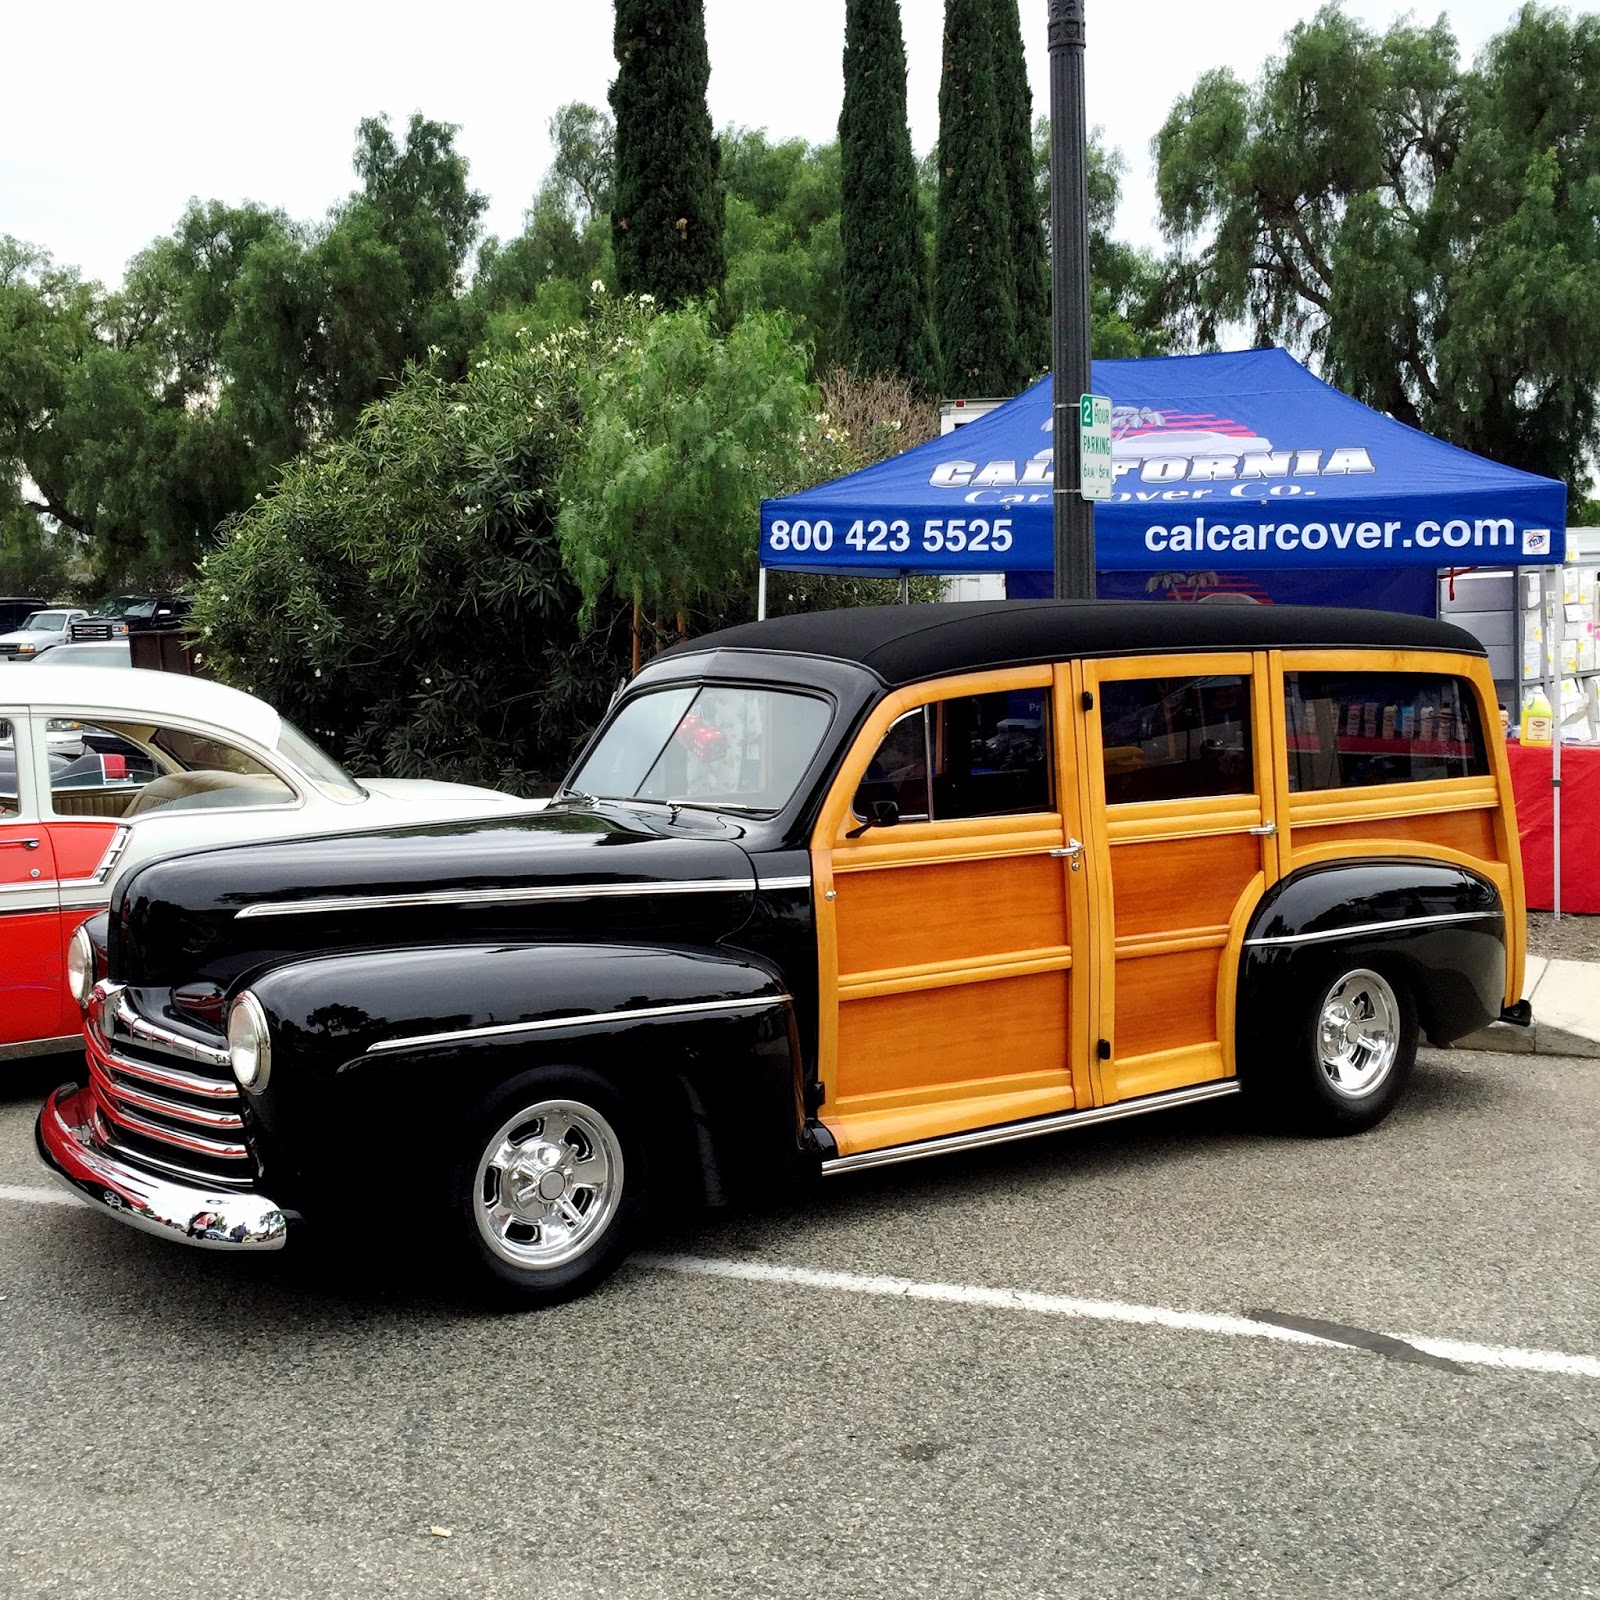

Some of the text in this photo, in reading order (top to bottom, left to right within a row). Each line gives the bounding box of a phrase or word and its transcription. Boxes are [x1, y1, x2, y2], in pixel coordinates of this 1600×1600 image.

[1083, 401, 1110, 425] 2 HOUR
[1083, 435, 1110, 456] PARKING
[928, 447, 1375, 489] CALFORNIA
[965, 482, 1316, 503] Car over Co.
[770, 519, 1012, 551] 800 423 5525
[1145, 518, 1514, 551] calcarcover.com
